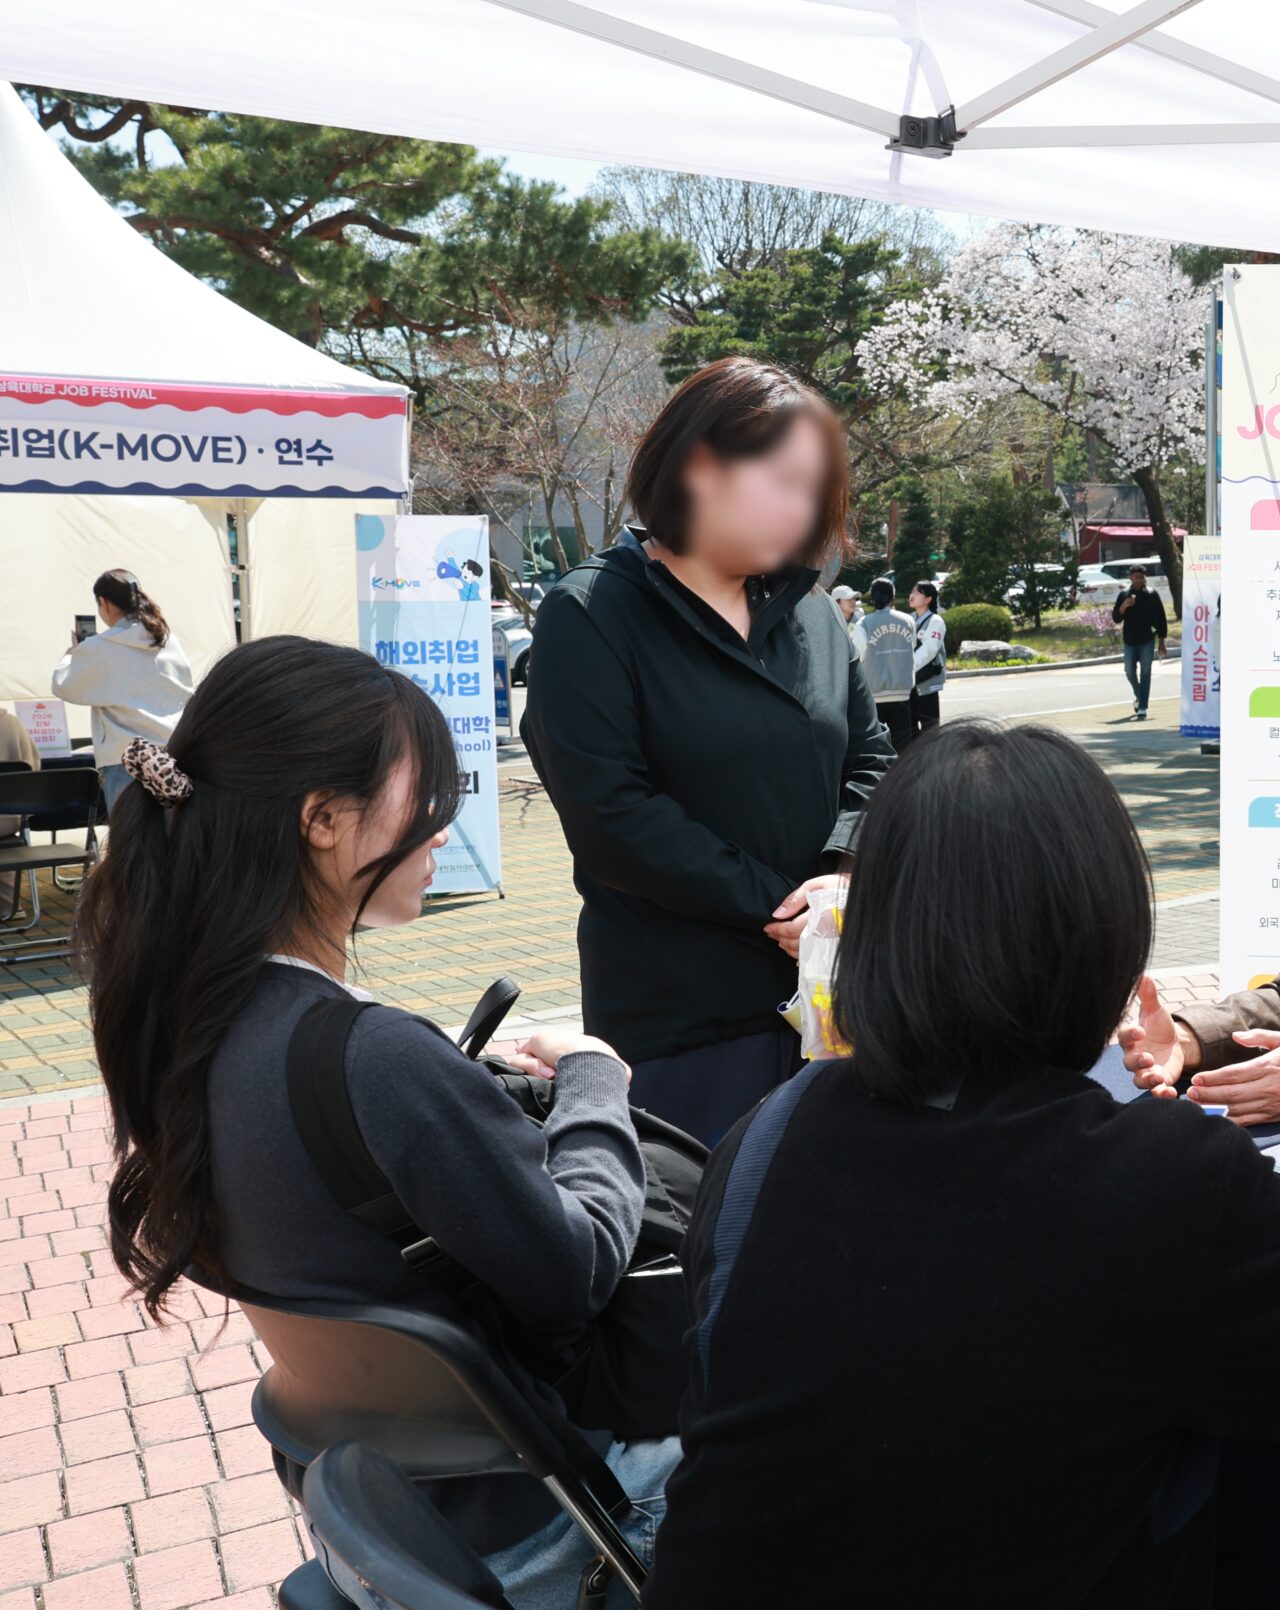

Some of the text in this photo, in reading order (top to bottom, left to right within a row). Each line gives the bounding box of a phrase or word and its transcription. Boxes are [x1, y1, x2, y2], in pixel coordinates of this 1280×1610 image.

[59, 384, 88, 398] JOB
[92, 387, 157, 400] FESTIVAL
[274, 437, 334, 467] 연수
[372, 576, 421, 590] K-MOVE
[376, 640, 480, 665] 해외취업
[1192, 604, 1211, 702] 아이스크림
[446, 716, 491, 734] 대학
